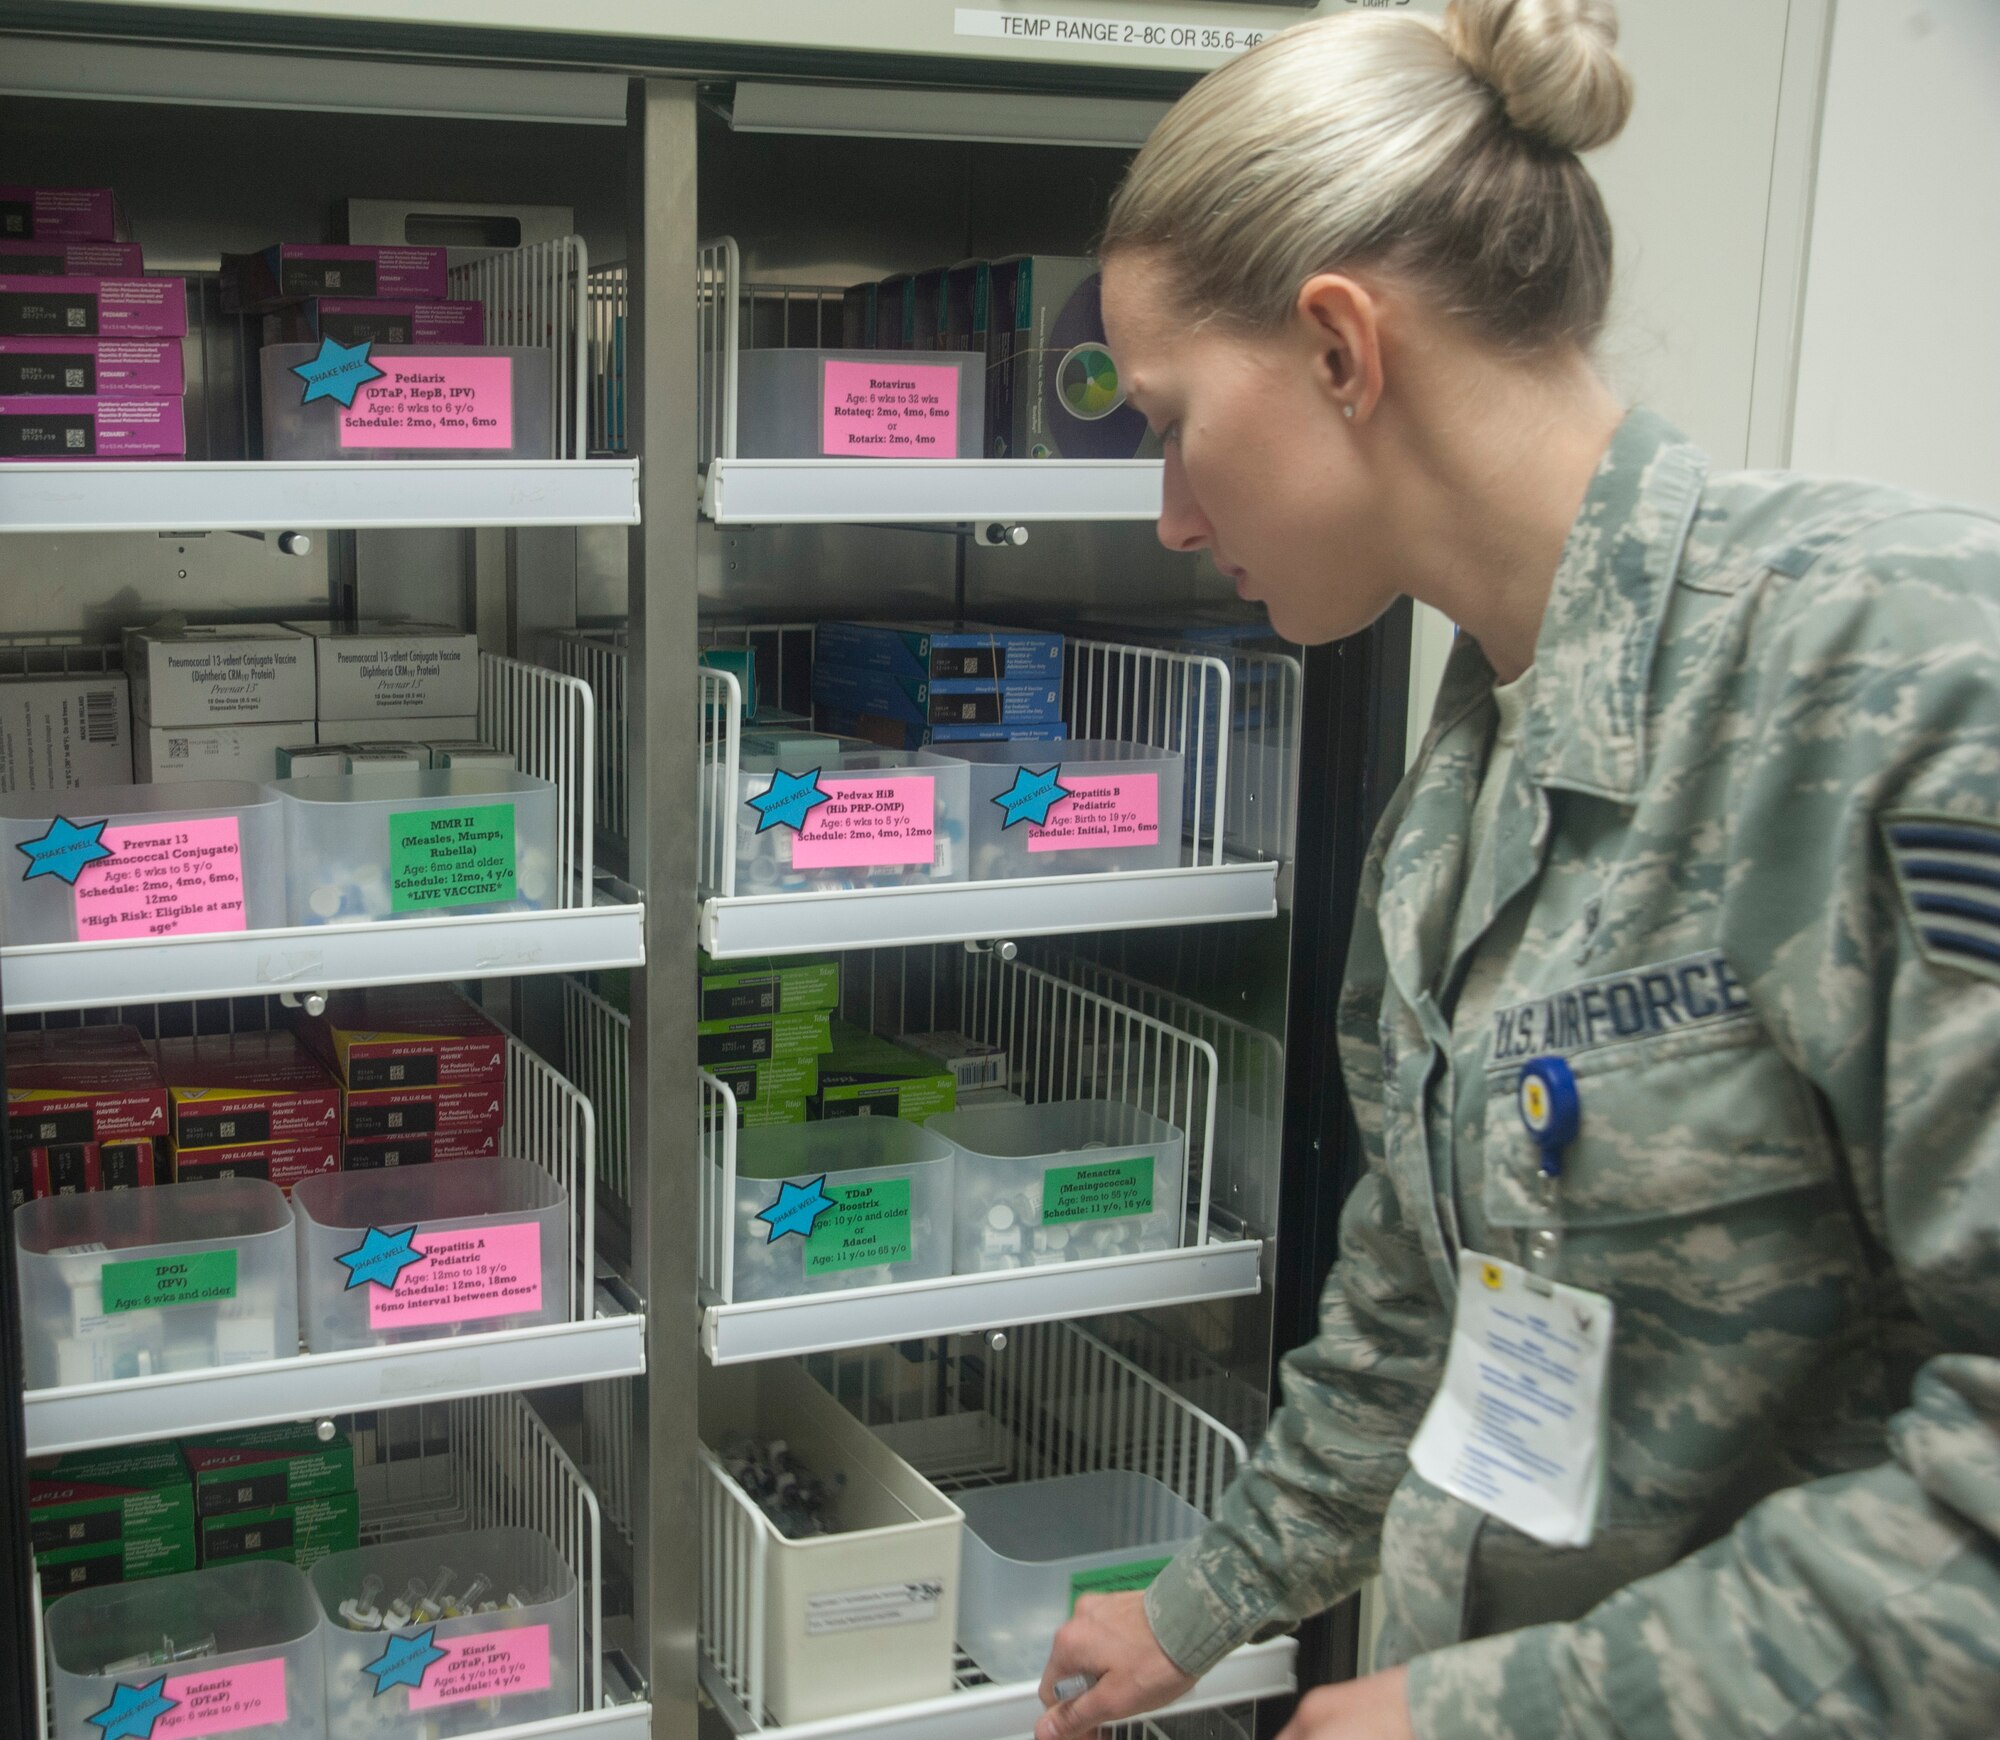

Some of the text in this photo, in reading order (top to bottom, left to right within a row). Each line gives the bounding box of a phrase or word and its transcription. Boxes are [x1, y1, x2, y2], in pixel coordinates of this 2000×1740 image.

[1001, 17, 1050, 36] TEMP
[1056, 21, 1118, 42] RANGE
[1123, 26, 1166, 45] 2-8C
[1171, 28, 1196, 46] OR
[310, 360, 363, 384] SHAKE WELL
[395, 373, 446, 384] Pediarix
[870, 379, 916, 389] Rotavirus
[366, 388, 475, 400] (DTaP, HepB, IPV)
[368, 403, 474, 414] Age: 6 wks to 6 y/o
[834, 406, 950, 418] Rotateq: 2mo, 4mo, 6mo
[345, 417, 497, 429] Schedule: 2mo, 4mo, 6mo
[887, 422, 898, 431] or
[848, 434, 935, 445] Rotarix: 2mo, 4mo
[338, 650, 461, 664] Pneumococcal 13-valent Conjugate Vaccine
[1050, 647, 1059, 658] B
[169, 654, 296, 667] Pneumococcal 13-valent Conjugate Vaccine
[192, 671, 227, 683] (Diphtheria
[251, 668, 275, 681] Protein)
[360, 667, 393, 679] (Diphtheria
[417, 665, 440, 676] Protein)
[211, 684, 244, 695] Prevnar
[377, 680, 410, 690] Prevnar
[1047, 692, 1056, 703] B
[837, 789, 895, 800] Pedvax HiB
[1008, 785, 1053, 811] SHAKE WELL
[1068, 787, 1121, 800] Hepatitis B
[764, 787, 812, 814] SHAKE WELL
[1072, 800, 1117, 811] Pediatric
[826, 802, 905, 815] (Hib PRP-OMP)
[430, 818, 475, 830] MMR II
[798, 828, 932, 841] Schedule: 2mo, 4mo, 12mo
[1028, 823, 1158, 839] Schedule: Initial, 1mo, 6mo
[123, 834, 189, 850] Prevnar 13
[401, 829, 504, 849] (Measles, Mumps,
[36, 840, 93, 861] SHAKE WELL
[173, 844, 239, 860] Conjugate)
[430, 846, 477, 858] Rubella)
[403, 857, 504, 877] Age: 6mo and older
[394, 878, 449, 889] Schedule:
[451, 873, 485, 883] 12mo,
[495, 868, 514, 880] y/o
[79, 873, 239, 898] Schedule: 2mo, 4mo, 6mo,
[145, 893, 178, 905] 12mo
[121, 908, 152, 923] Risk:
[155, 904, 203, 920] Eligible
[206, 901, 218, 912] at
[221, 899, 243, 912] any
[150, 1107, 163, 1119] A
[324, 1107, 336, 1120] A
[1077, 1168, 1121, 1180] Menactra
[1060, 1177, 1137, 1194] (Meningococcal)
[845, 1188, 873, 1198] TDaP
[773, 1196, 818, 1225] SHAKE WELL
[839, 1200, 880, 1212] Boostrix
[1044, 1206, 1088, 1219] Schedule:
[1091, 1204, 1101, 1213] 11
[1124, 1200, 1134, 1208] 16
[1135, 1198, 1151, 1209] y/o
[854, 1227, 865, 1235] or
[425, 1239, 486, 1255] Hepatitis A
[842, 1236, 876, 1248] Adacel
[354, 1245, 405, 1272] SHAKE WELL
[430, 1254, 481, 1267] Pediatric
[156, 1264, 188, 1276] IPOL
[157, 1277, 188, 1291] (IPV)
[394, 1275, 518, 1298] Schedule: 12mo, 18mo
[115, 1298, 142, 1310] Age:
[153, 1293, 176, 1304] wks
[178, 1289, 199, 1301] and
[201, 1286, 231, 1298] older
[407, 1295, 451, 1309] interval
[453, 1291, 500, 1304] between
[462, 1643, 496, 1657] Kinrix
[487, 1653, 511, 1666] IPV)
[185, 1679, 233, 1695] Infanrix
